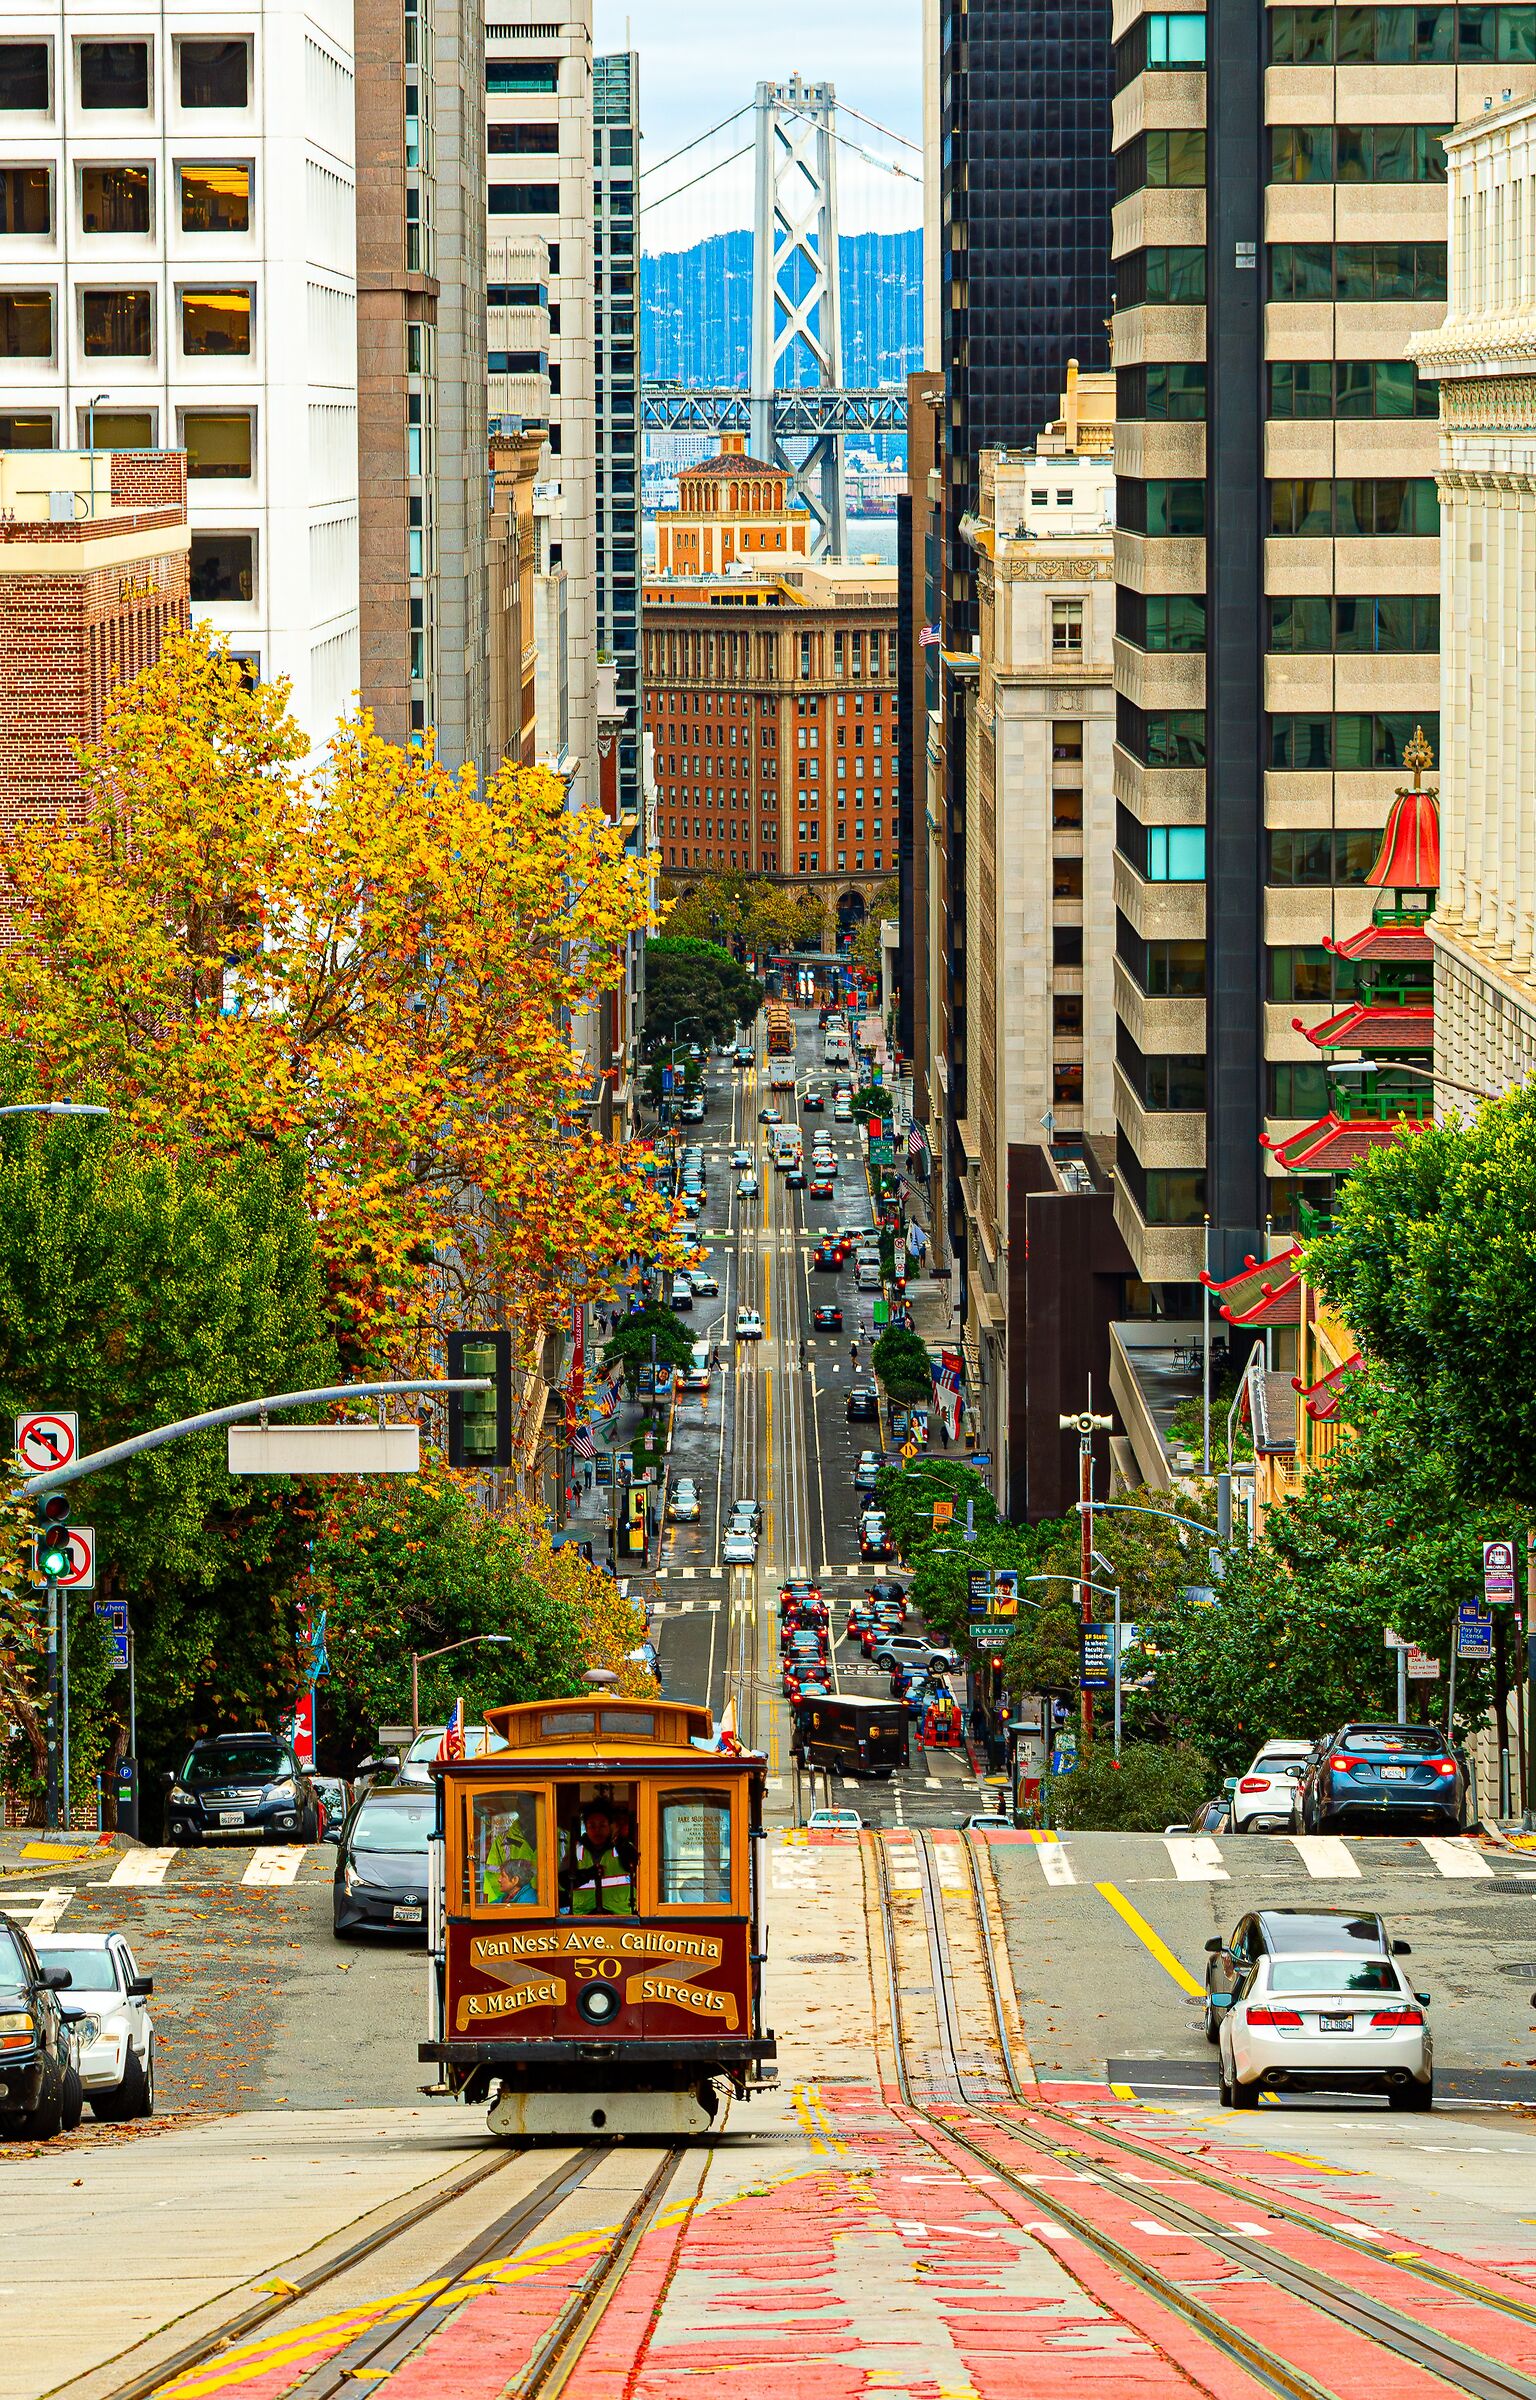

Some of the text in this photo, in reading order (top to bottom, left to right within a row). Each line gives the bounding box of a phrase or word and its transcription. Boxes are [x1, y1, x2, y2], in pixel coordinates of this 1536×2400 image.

[828, 1039, 847, 1047] FedEx
[902, 1109, 911, 1124] 201
[975, 1627, 1010, 1635] Kearny
[476, 1938, 510, 1958] Van
[512, 1934, 559, 1954] Ness
[620, 1932, 719, 1959] California
[573, 1958, 622, 1980] 50
[467, 1982, 558, 2014] & Market
[642, 1980, 726, 2011] Streets
